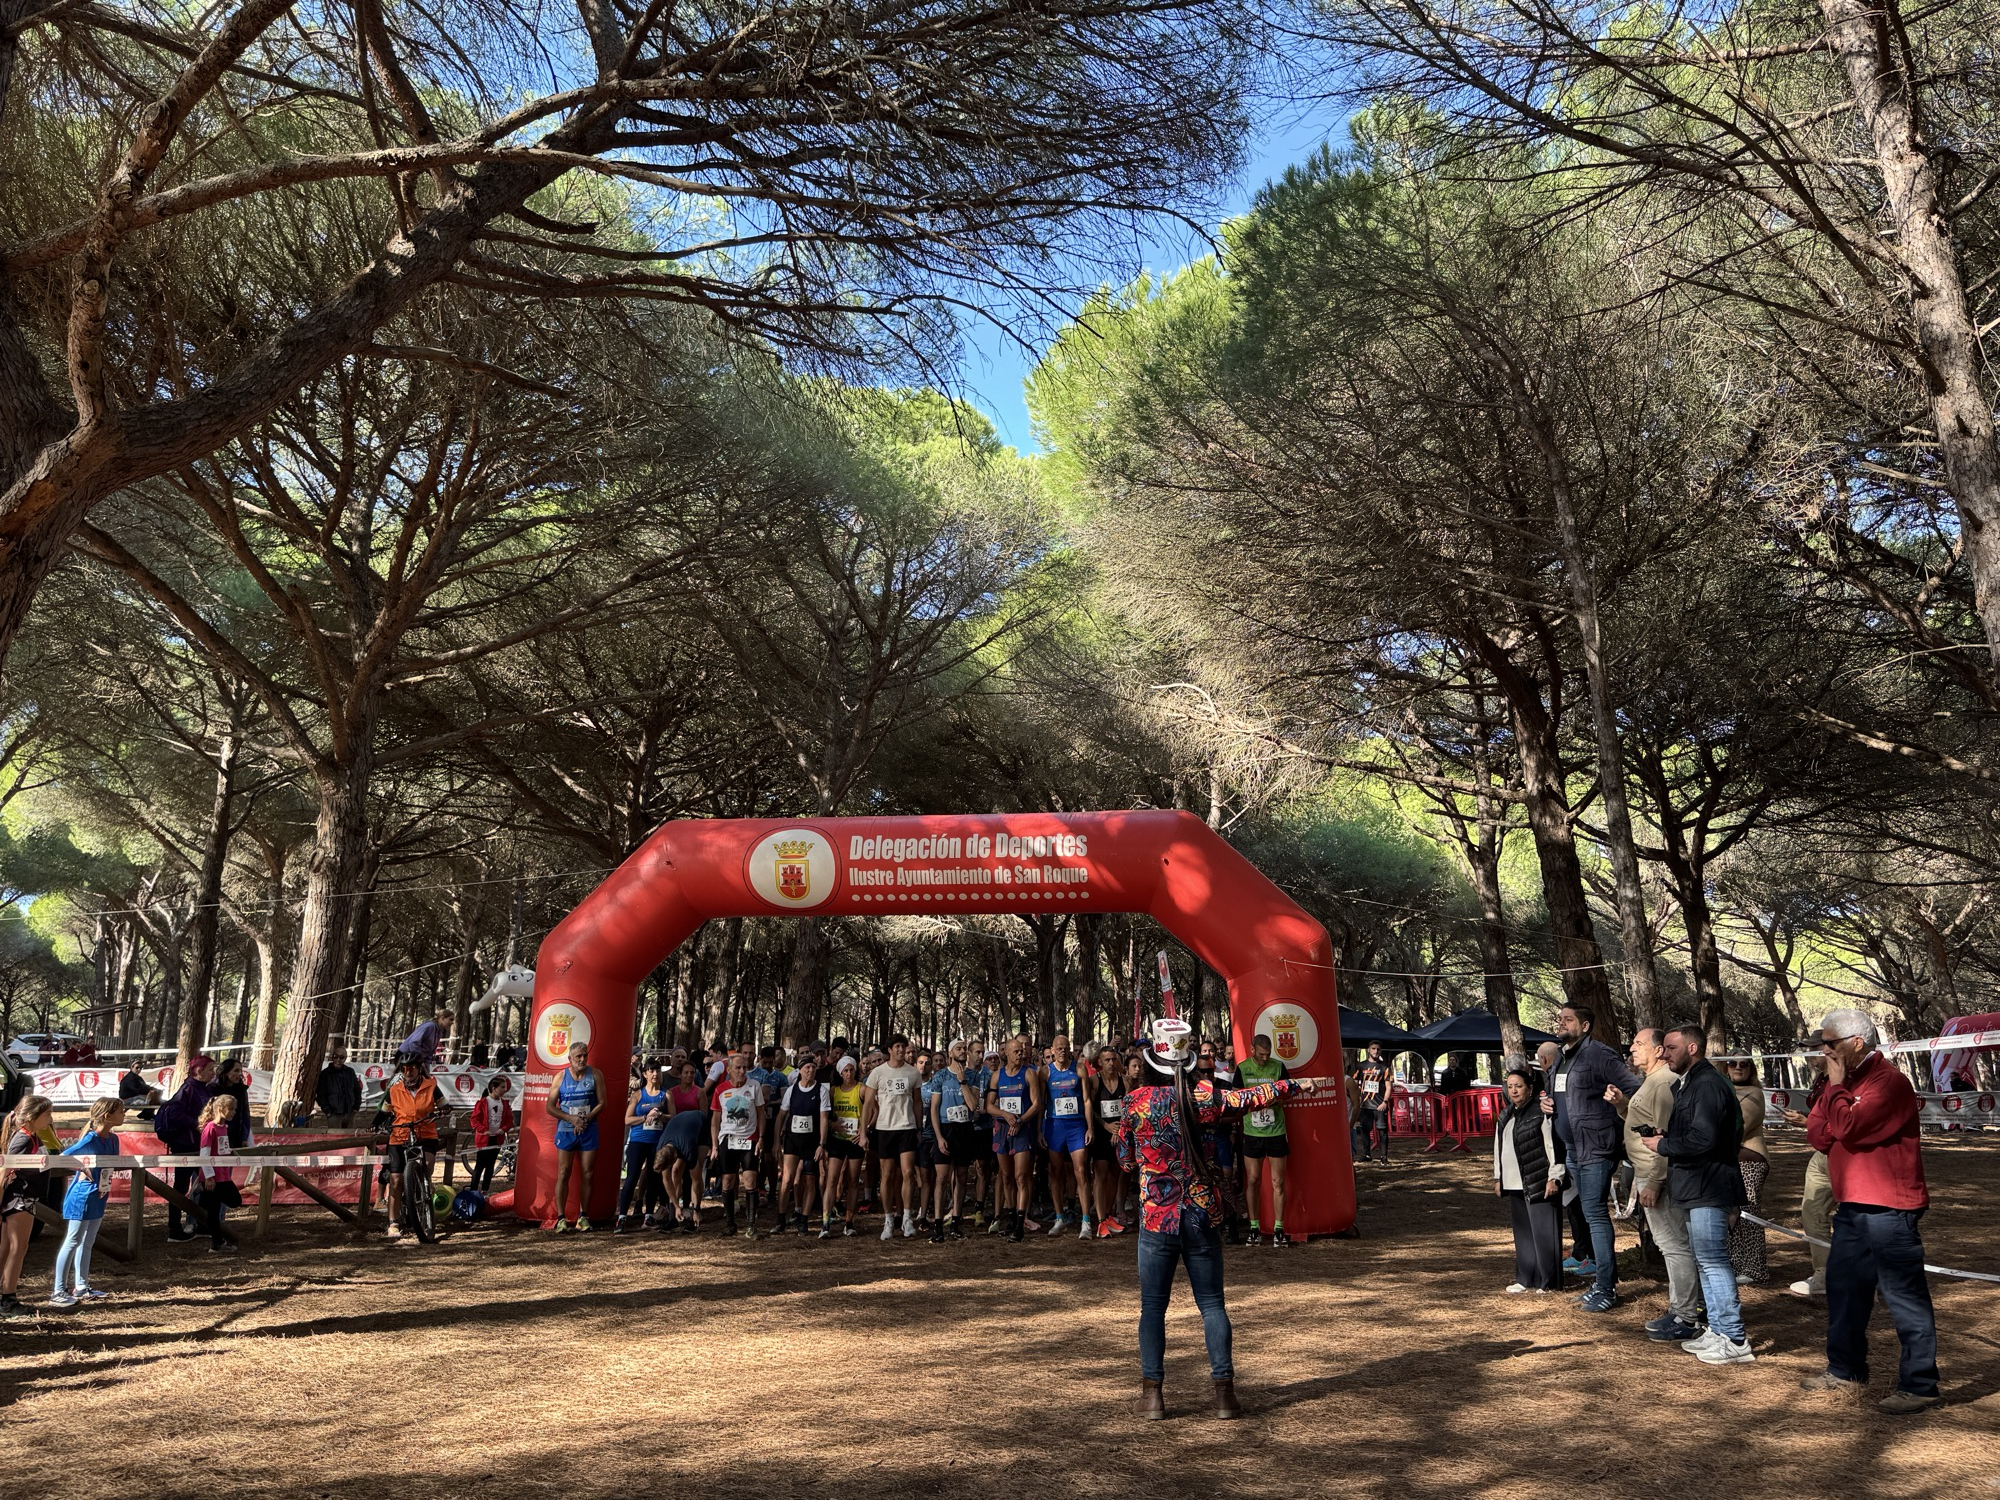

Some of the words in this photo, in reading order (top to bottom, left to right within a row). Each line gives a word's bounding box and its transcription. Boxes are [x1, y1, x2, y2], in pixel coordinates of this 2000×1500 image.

[850, 834, 961, 863] Delegación
[966, 834, 991, 859] de
[995, 833, 1088, 861] Deportes
[849, 867, 895, 886] Ilustre
[897, 866, 992, 887] Ayuntamiento
[994, 866, 1012, 884] de
[1014, 865, 1041, 884] San
[1043, 865, 1089, 886] Roque
[895, 1082, 905, 1090] 38
[1006, 1102, 1017, 1110] 95
[1064, 1102, 1074, 1110] 49
[955, 1110, 968, 1119] 112
[1260, 1114, 1271, 1123] 92
[799, 1121, 809, 1129] 26
[845, 1122, 853, 1130] 44
